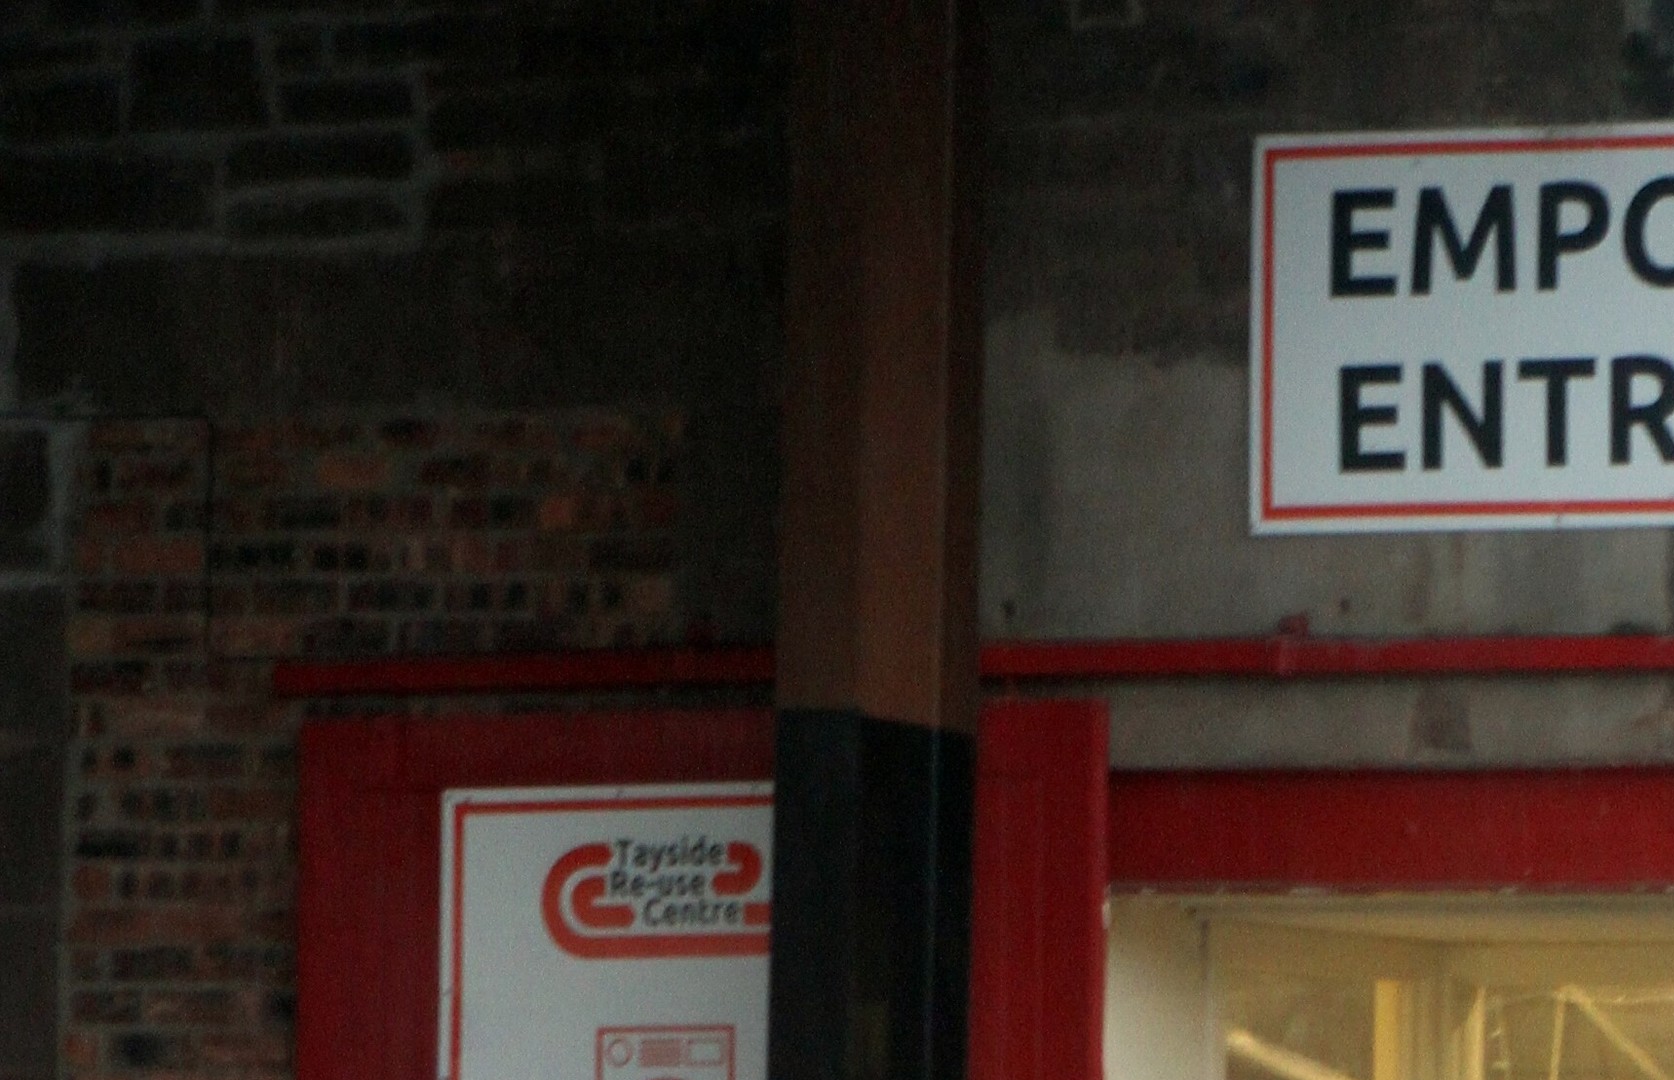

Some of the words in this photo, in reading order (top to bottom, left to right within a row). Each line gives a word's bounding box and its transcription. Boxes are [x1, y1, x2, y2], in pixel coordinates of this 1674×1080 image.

[613, 836, 726, 872] Tayside
[609, 870, 708, 899] Re-use
[642, 898, 742, 927] Centre
